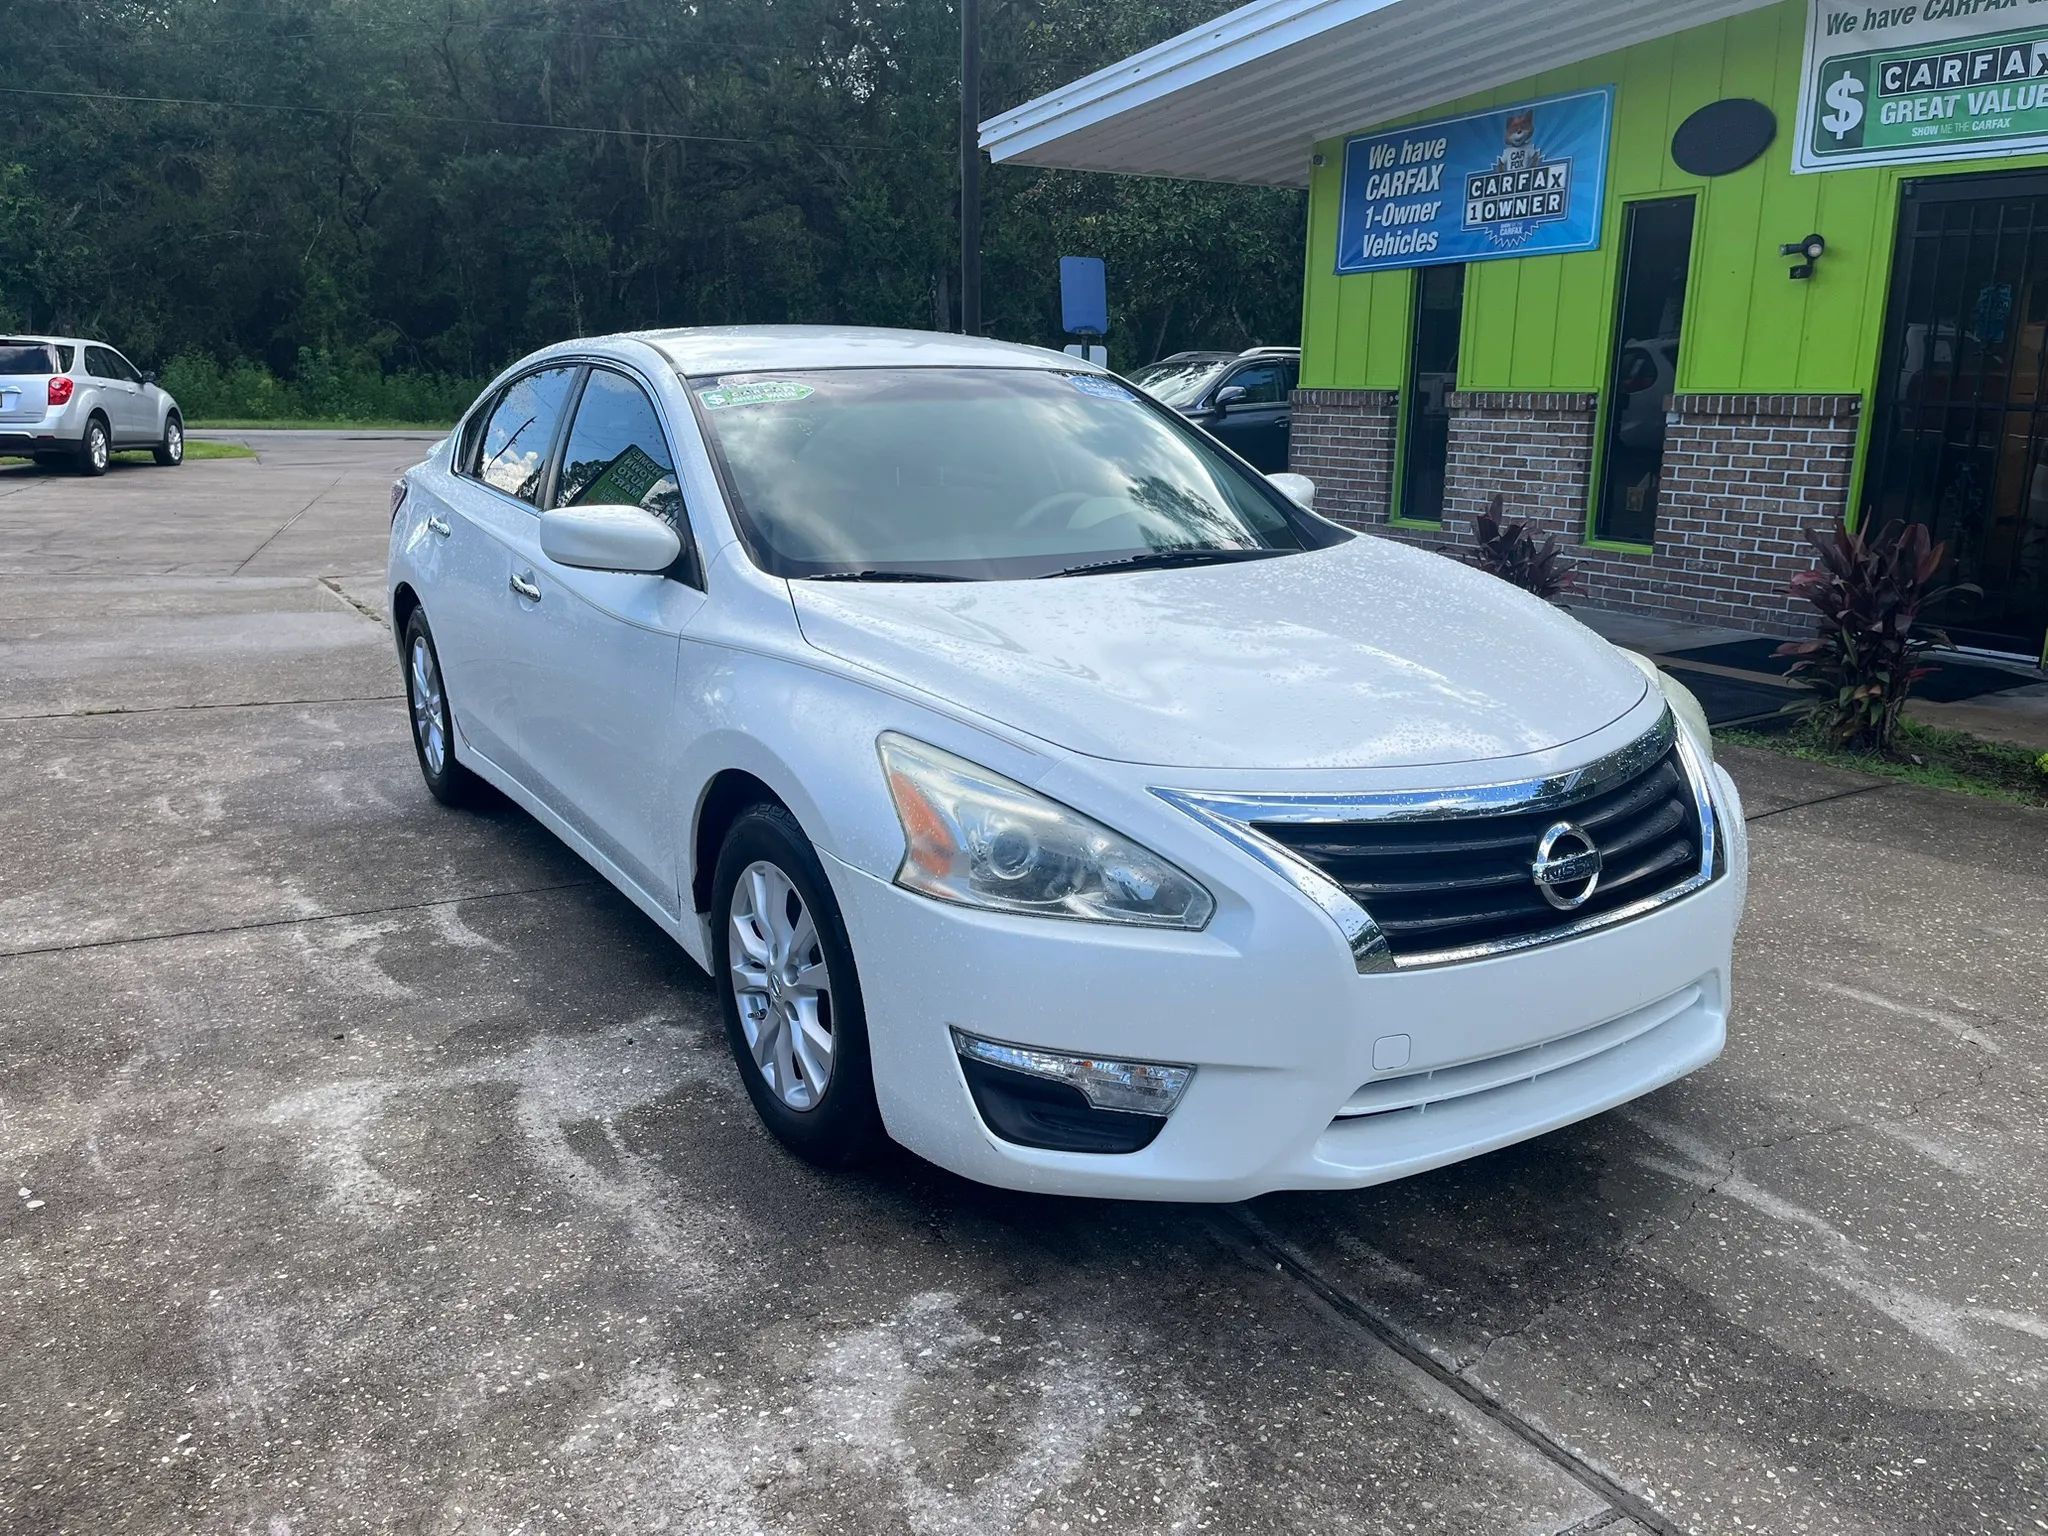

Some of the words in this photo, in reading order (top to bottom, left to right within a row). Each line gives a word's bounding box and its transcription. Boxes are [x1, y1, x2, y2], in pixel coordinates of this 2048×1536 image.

[1826, 12, 1857, 37] We
[1862, 4, 1916, 31] have
[1880, 95, 1961, 126] GREAT
[1968, 83, 2048, 116] VALUE
[1911, 125, 1939, 137] SHOW
[1941, 124, 1953, 134] ME
[1955, 122, 1970, 133] THE
[1972, 117, 2012, 131] CARFAX
[1368, 144, 1396, 170] We
[1402, 137, 1447, 163] have
[1510, 150, 1525, 161] CAR
[1510, 160, 1524, 169] FOX
[1365, 163, 1445, 201] CARFAX
[1470, 171, 1564, 198] CARFAX
[1365, 201, 1442, 230] 1-Owner
[1362, 231, 1439, 258] Vehicles
